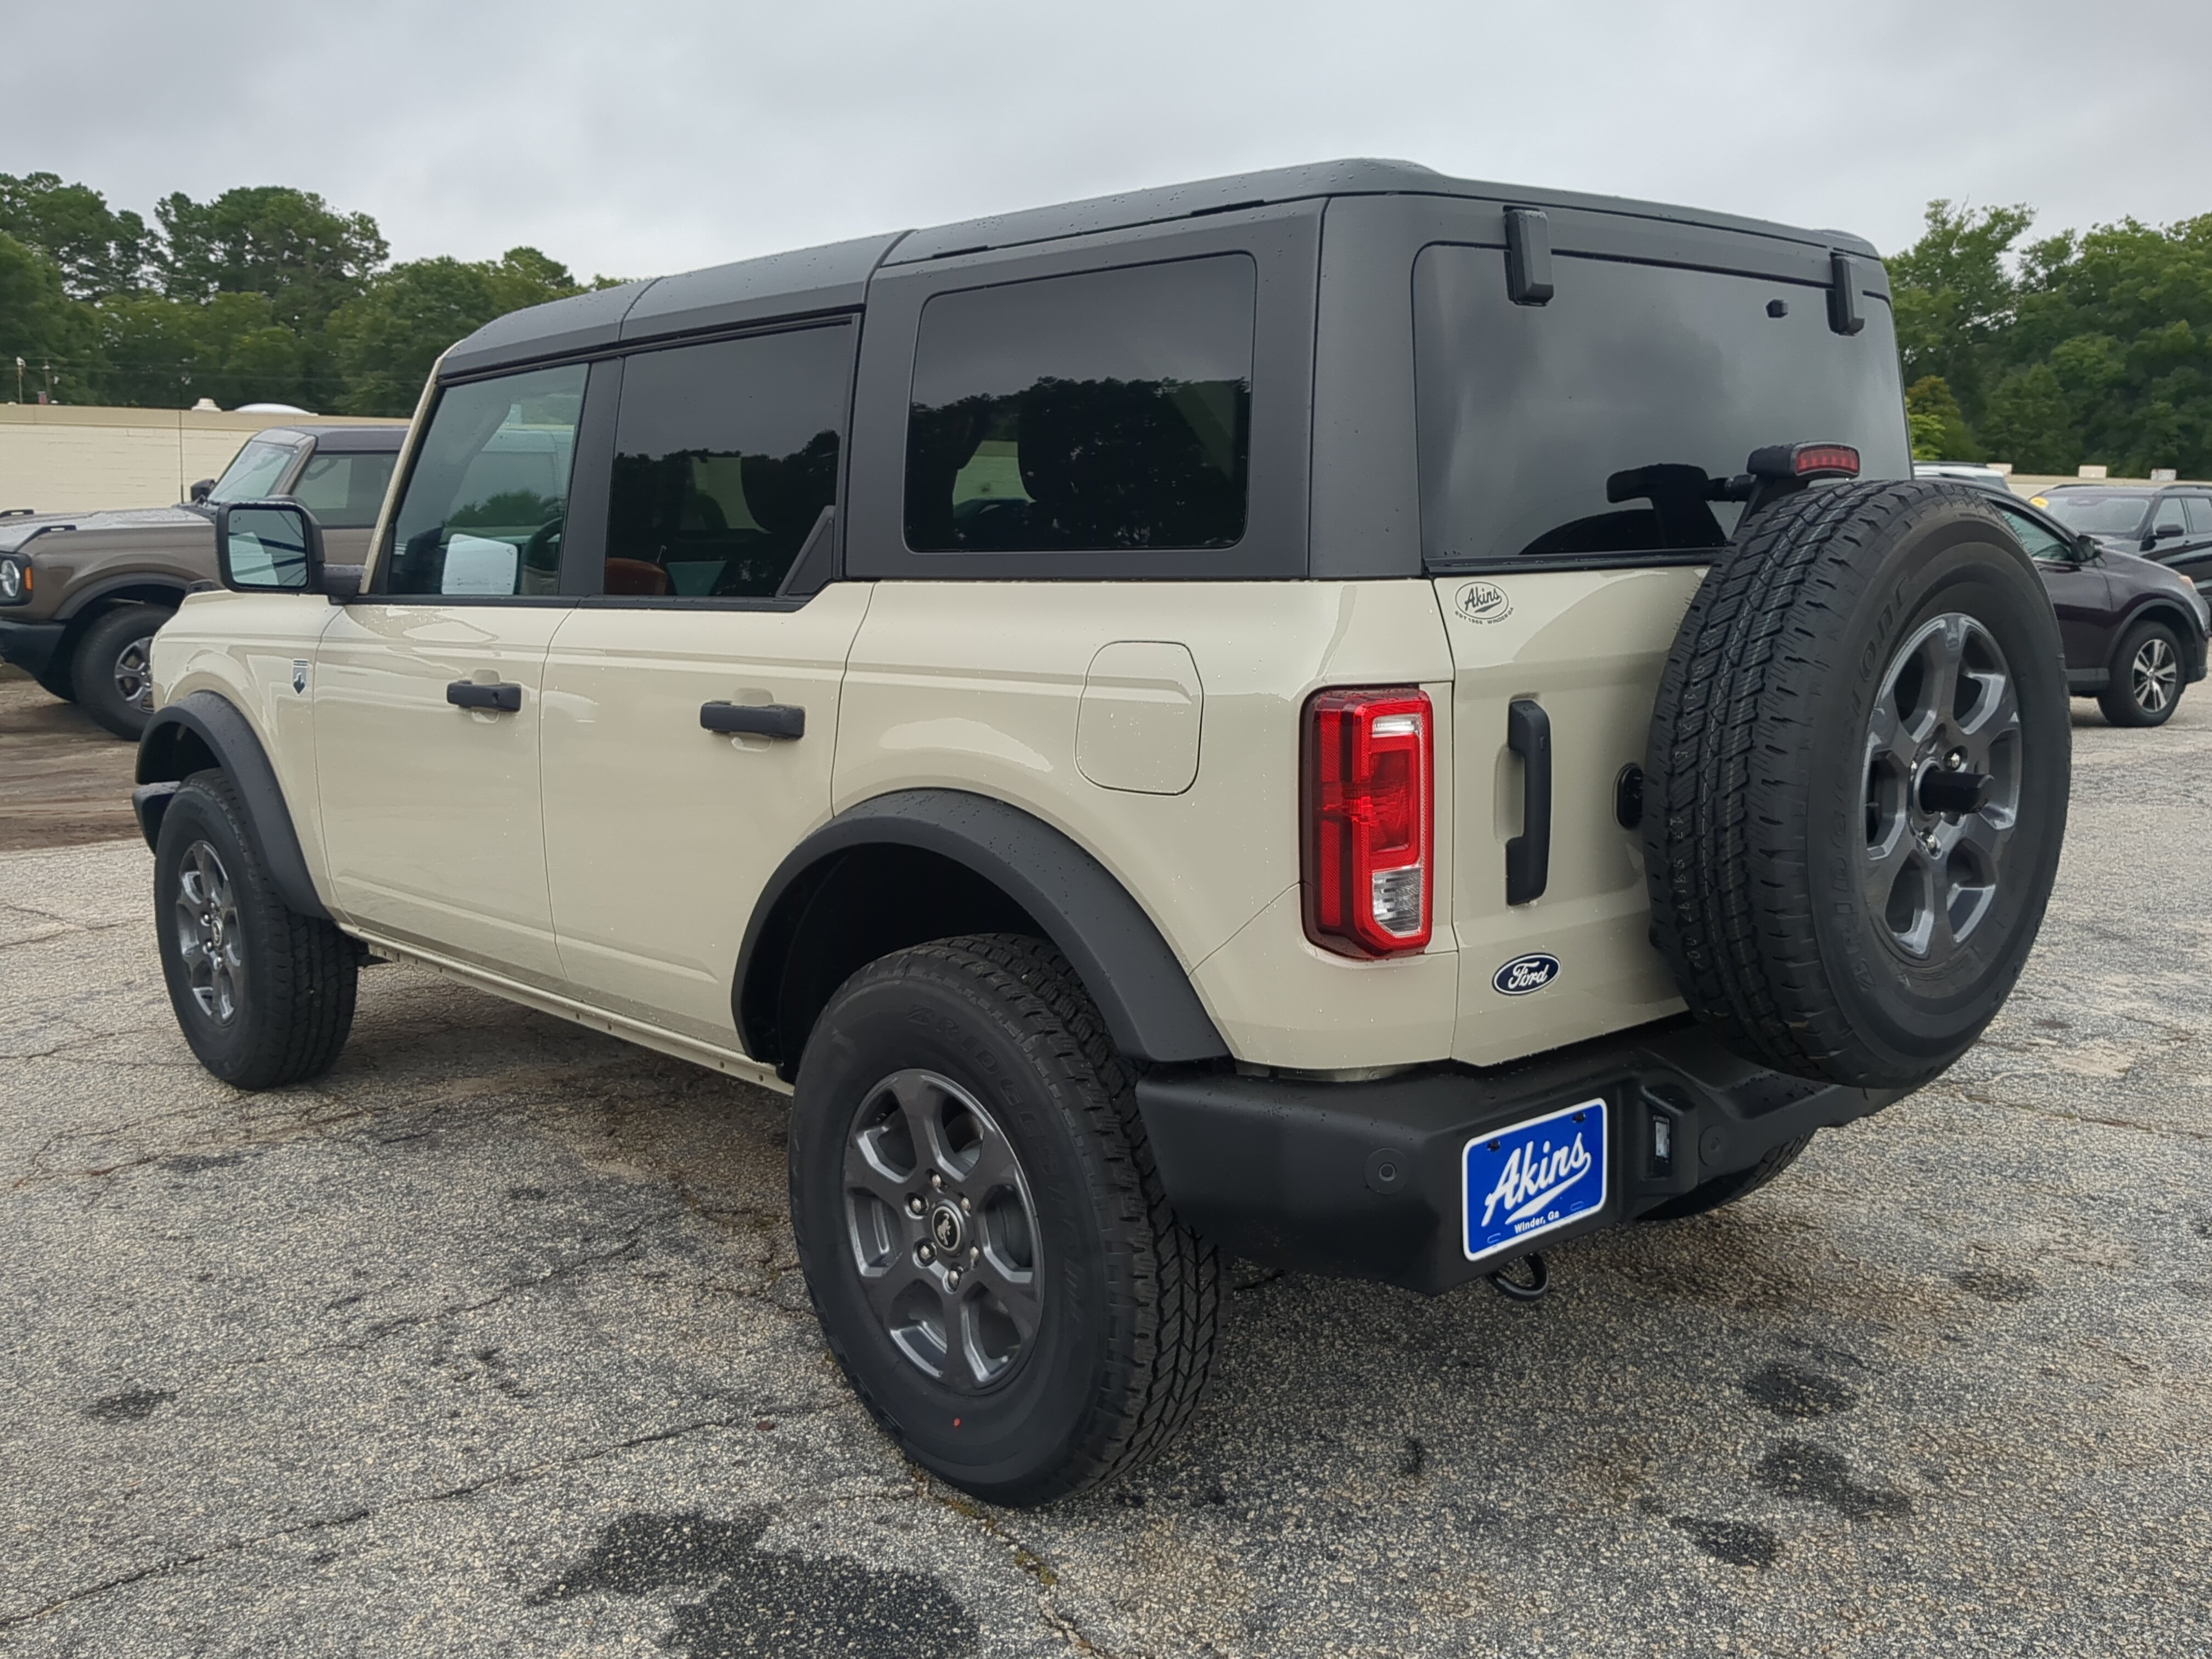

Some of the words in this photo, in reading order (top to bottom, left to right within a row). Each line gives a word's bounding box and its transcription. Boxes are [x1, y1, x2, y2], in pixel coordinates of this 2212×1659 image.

[1464, 586, 1502, 611] Akins
[1455, 611, 1467, 620] EST
[1487, 614, 1508, 624] WINDER
[1508, 607, 1514, 616] GA
[1508, 961, 1549, 989] Ford
[1481, 1132, 1589, 1227] Akins
[1514, 1216, 1546, 1234] Winder,
[1548, 1210, 1560, 1222] Ga
